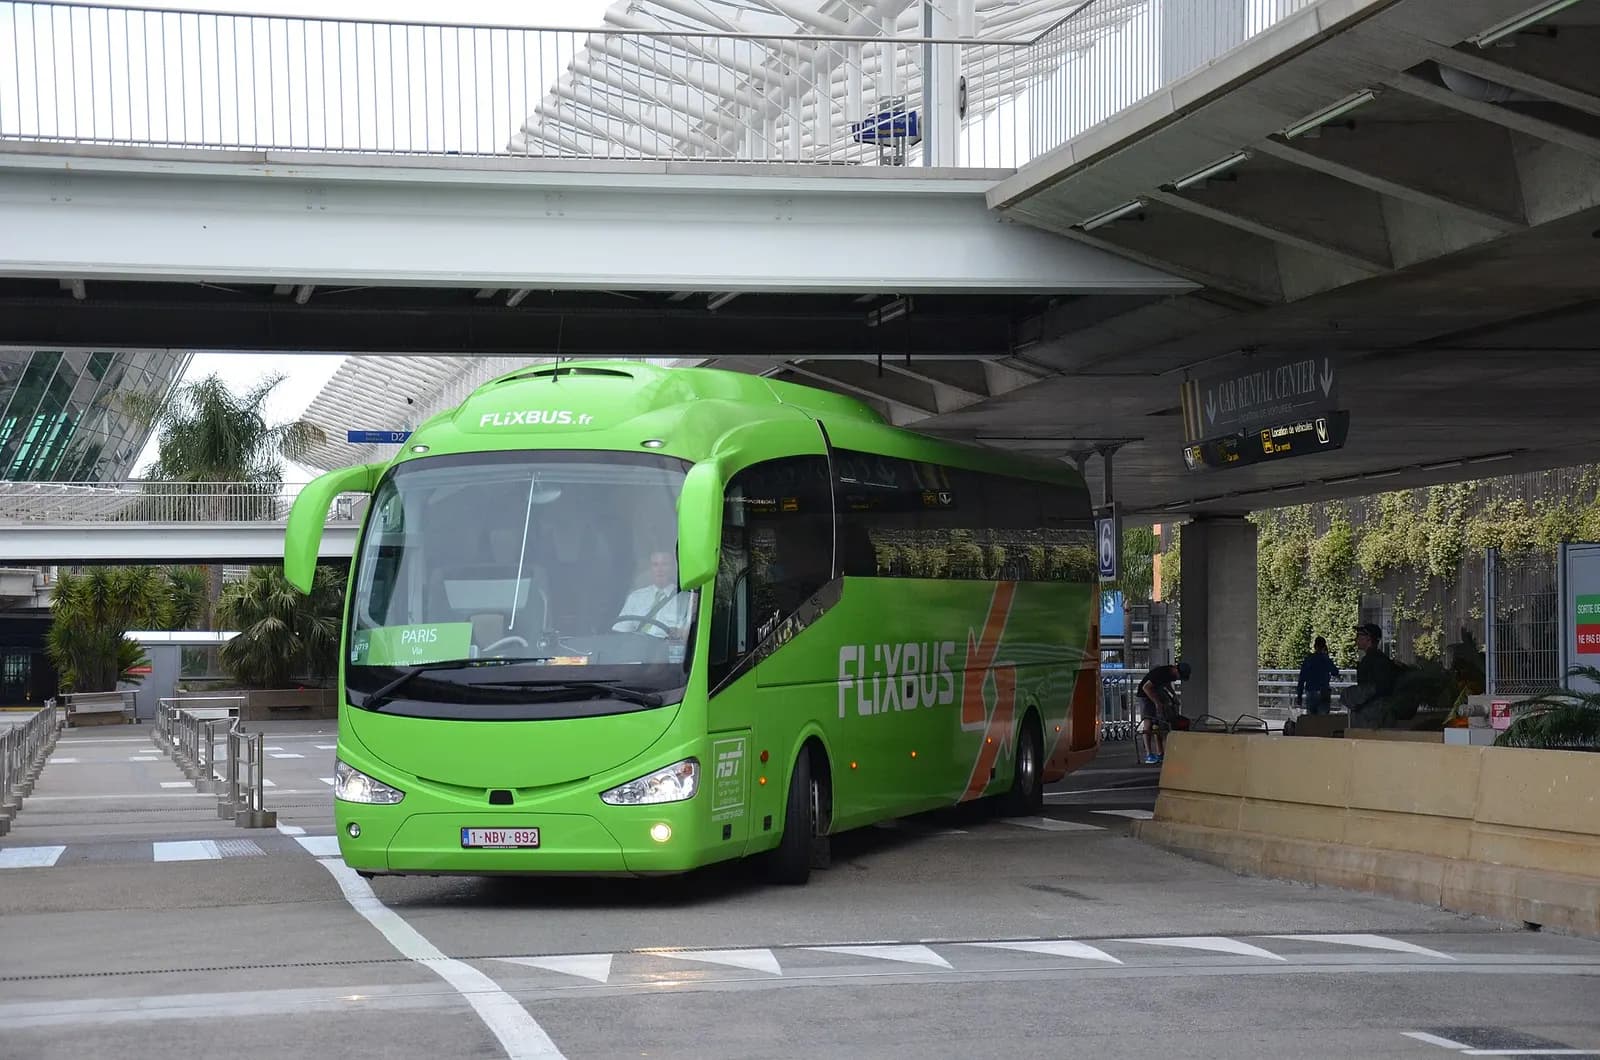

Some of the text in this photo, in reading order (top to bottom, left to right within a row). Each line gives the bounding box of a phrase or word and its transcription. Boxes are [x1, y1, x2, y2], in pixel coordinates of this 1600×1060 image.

[1218, 359, 1316, 413] CAR RENTAL CENTER
[391, 432, 405, 442] D2
[1271, 427, 1289, 438] Location
[1101, 522, 1112, 568] 6
[1577, 604, 1594, 614] SORTIE
[401, 628, 438, 645] PARIS
[1578, 634, 1585, 644] NE
[1585, 634, 1595, 644] PAS
[411, 646, 423, 656] Via
[471, 831, 537, 844] 1-NBV-892
